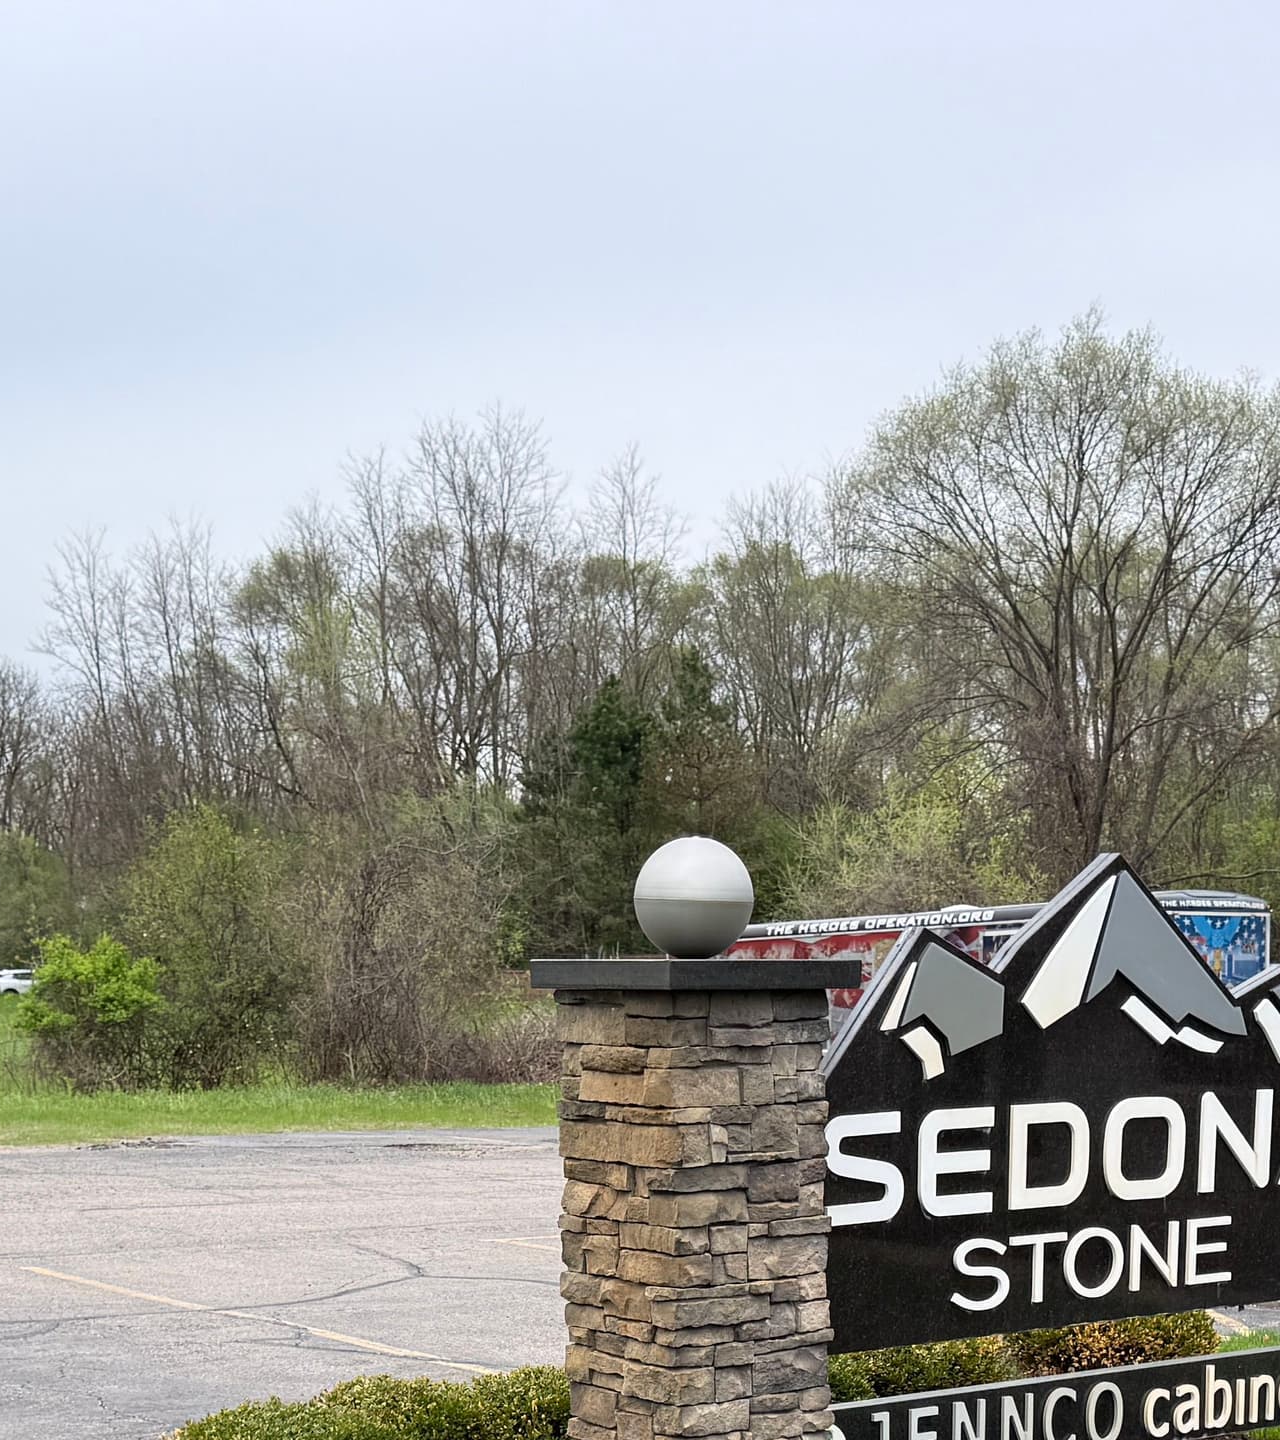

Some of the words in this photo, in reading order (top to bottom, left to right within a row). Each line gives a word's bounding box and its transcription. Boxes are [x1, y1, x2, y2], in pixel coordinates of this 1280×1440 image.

[766, 926, 793, 936] THE
[798, 922, 859, 934] HEROES
[864, 910, 995, 930] OPERATION.ORG
[950, 1215, 1233, 1311] STONE
